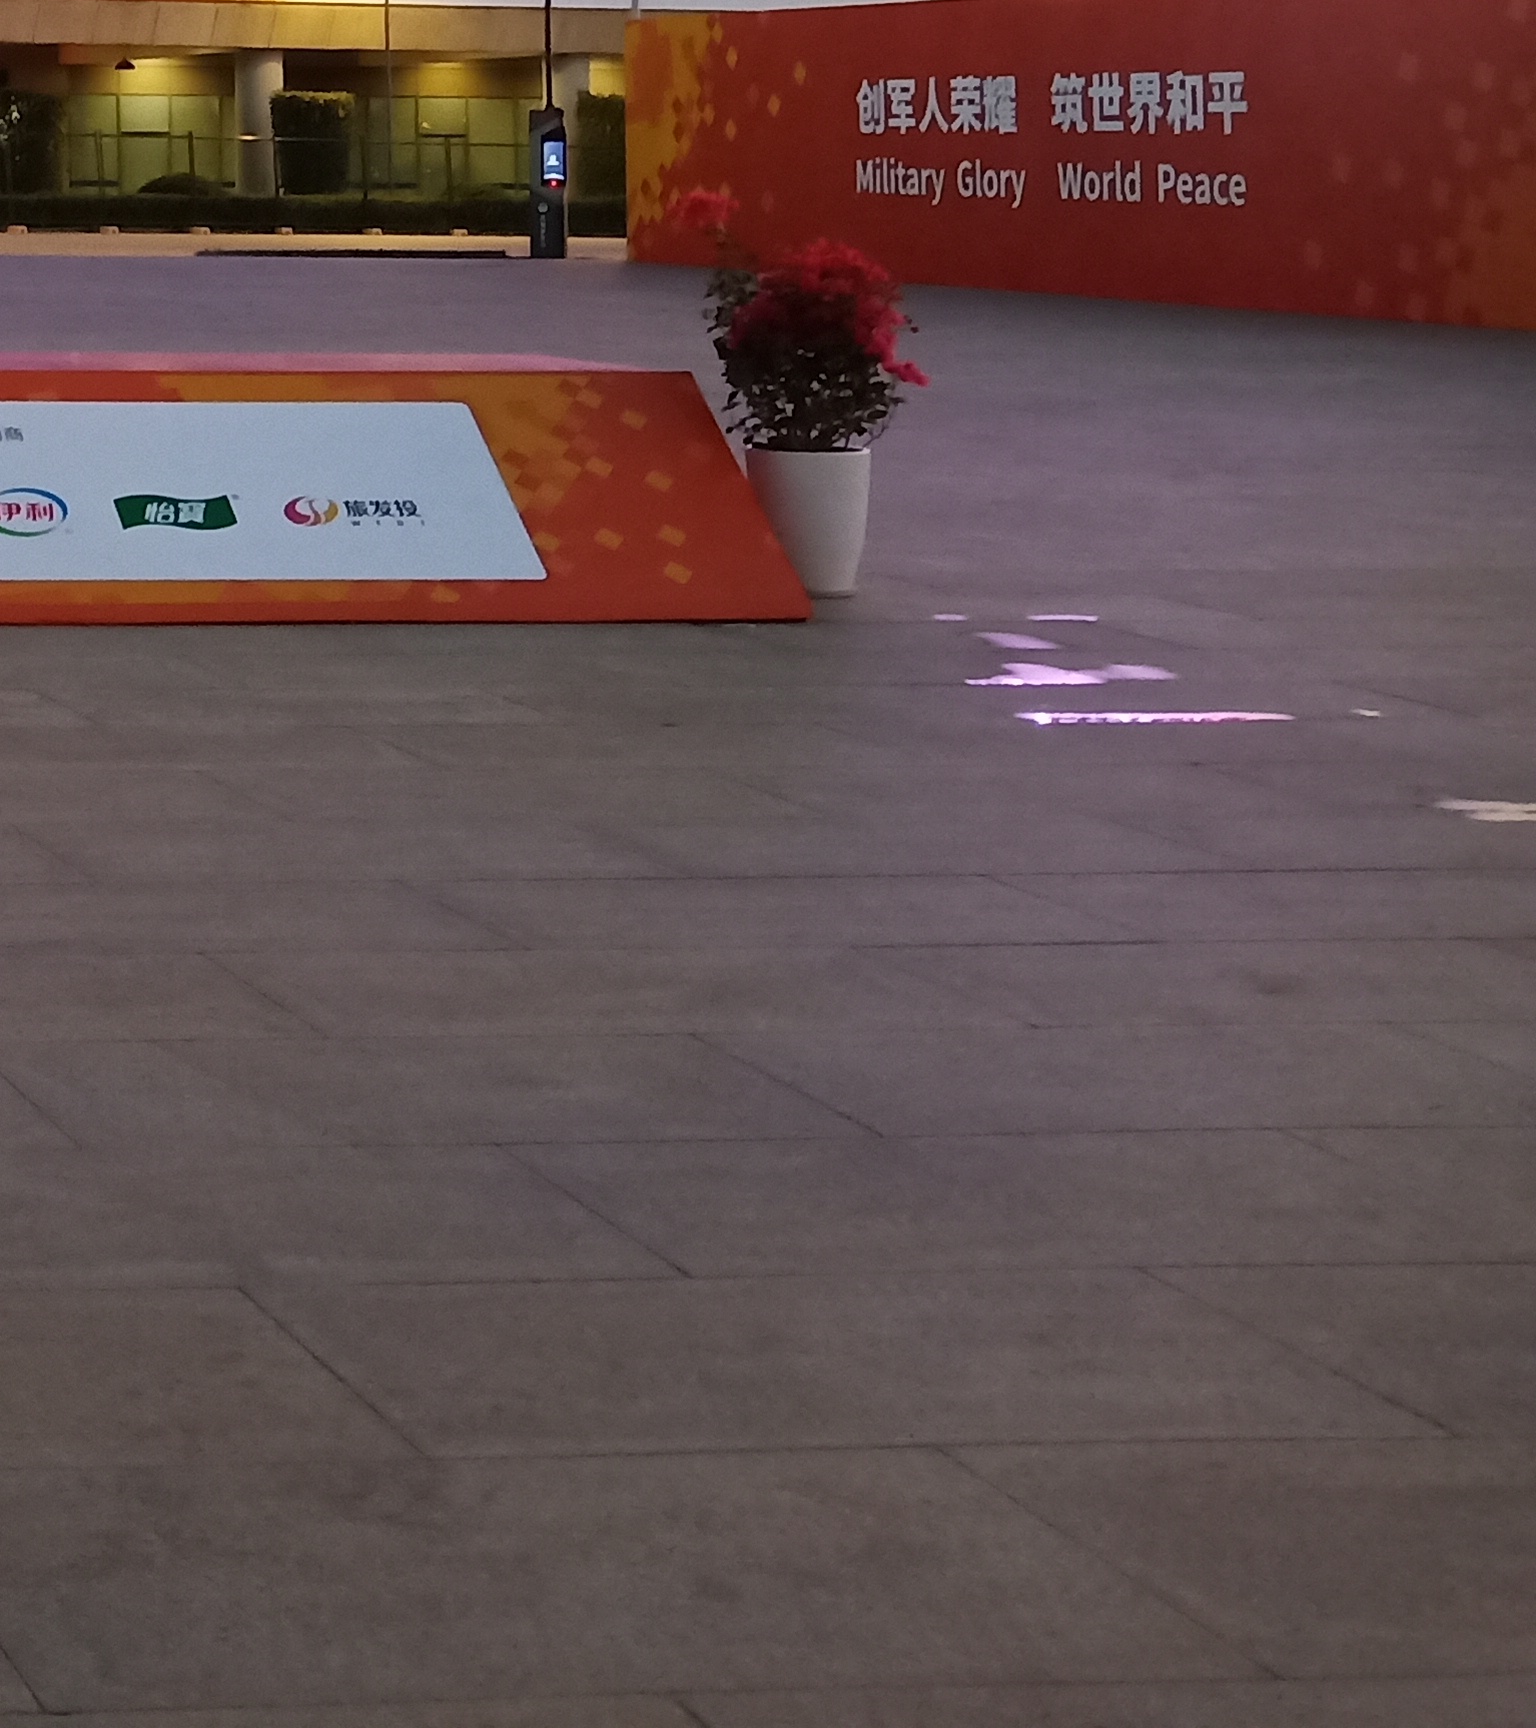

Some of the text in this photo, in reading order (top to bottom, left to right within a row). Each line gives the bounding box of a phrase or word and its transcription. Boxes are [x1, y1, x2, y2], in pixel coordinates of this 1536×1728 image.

[856, 70, 1248, 135] 创军人荣耀 筑世界和平
[856, 157, 1247, 208] Military Glory World Peace
